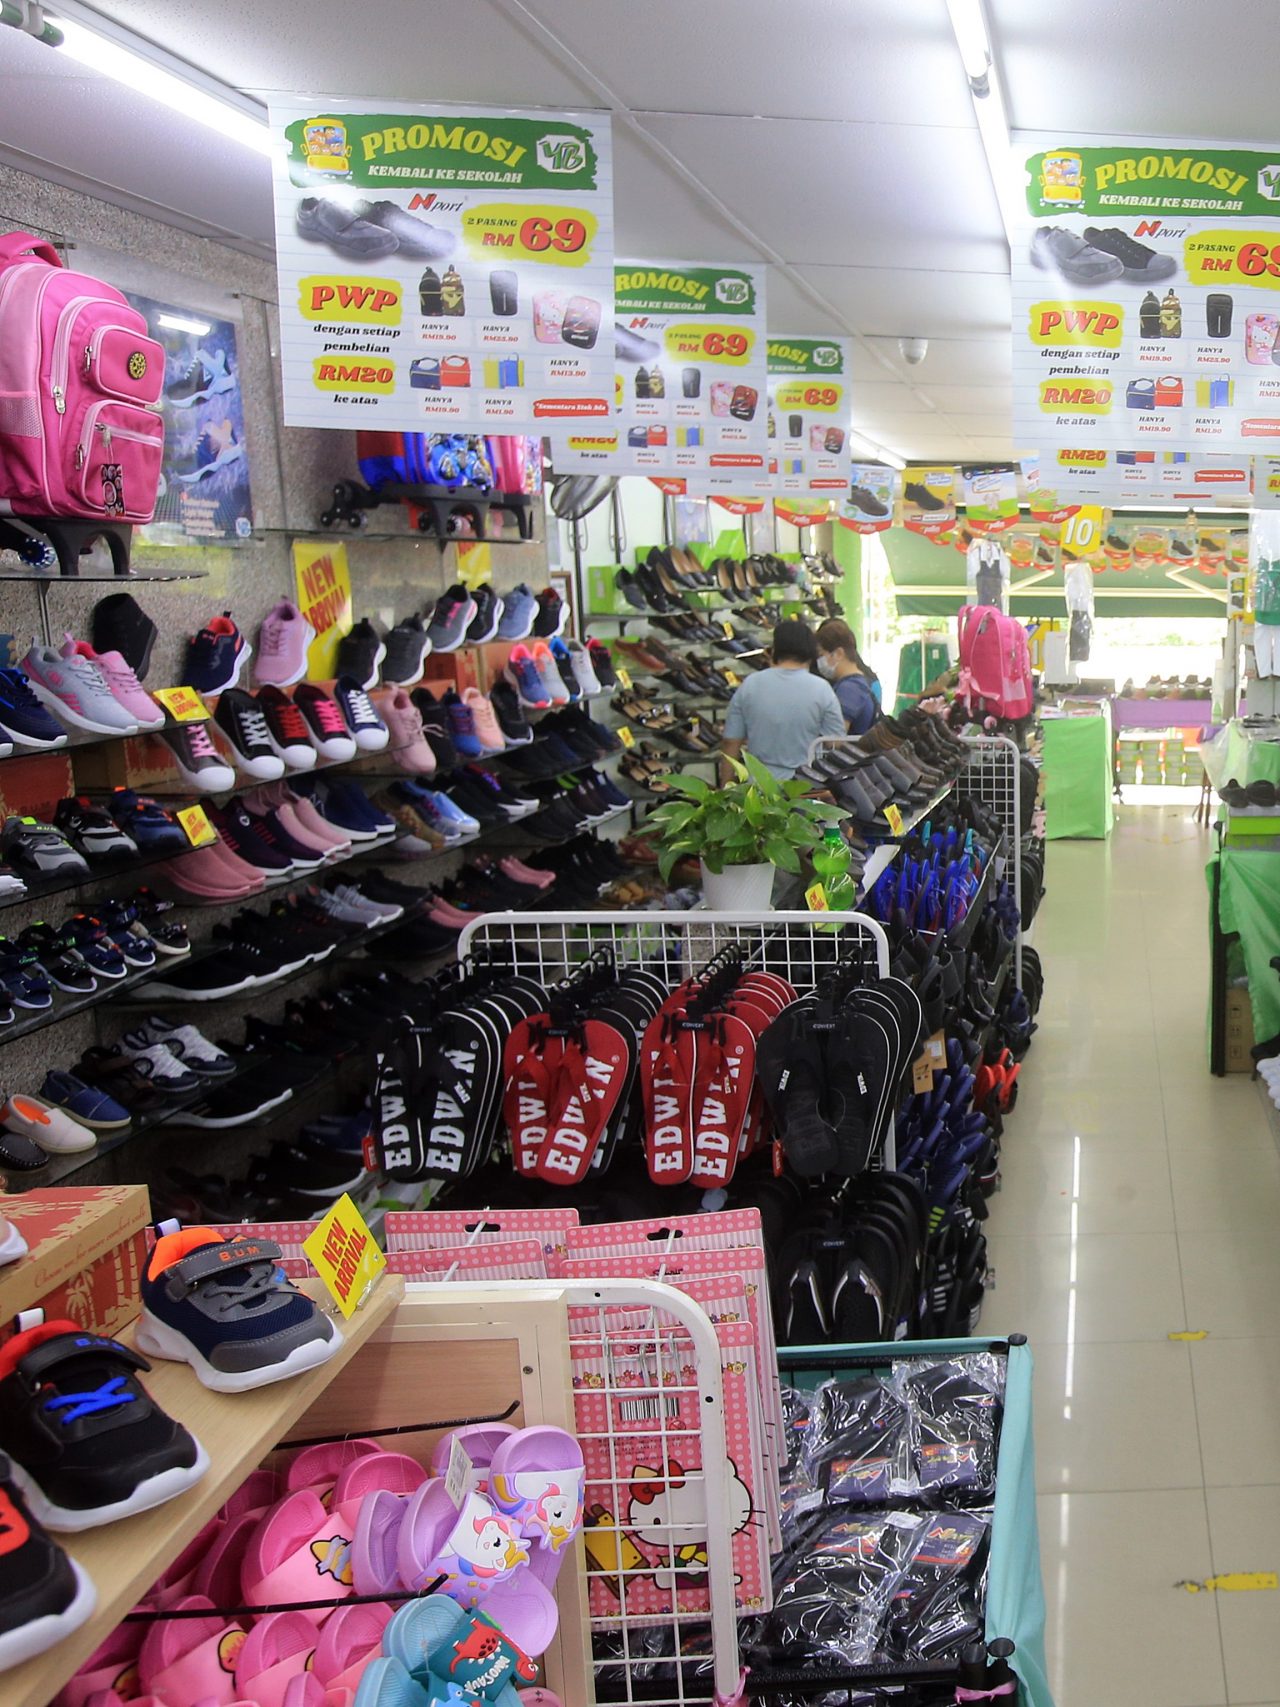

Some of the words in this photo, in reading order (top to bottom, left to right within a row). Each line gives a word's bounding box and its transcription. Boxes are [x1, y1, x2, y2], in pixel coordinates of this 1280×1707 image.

[361, 124, 527, 168] PROMOSI
[367, 165, 433, 179] KEMBALI
[435, 168, 456, 180] KE
[457, 169, 523, 183] SEKOLAH
[1095, 155, 1250, 196] PROMOSI
[1099, 194, 1160, 207] KEMBALI
[1162, 197, 1181, 209] KE
[1182, 198, 1243, 211] SEKOLAH
[467, 217, 475, 225] 2
[476, 217, 517, 227] PASANG
[482, 232, 515, 247] RM
[519, 217, 586, 253] 69
[1189, 243, 1196, 251] 2
[1197, 243, 1236, 253] PASANG
[1201, 257, 1232, 272] RM
[615, 271, 710, 300] ROMOSI
[310, 284, 398, 313] PWP
[313, 323, 359, 337] dengan
[361, 326, 401, 338] setiap
[1039, 309, 1120, 337] PWP
[323, 341, 390, 354] pembelian
[678, 342, 699, 353] RM
[703, 332, 748, 356] 69
[1197, 346, 1223, 354] HANYA
[767, 343, 809, 364] MOSI
[1041, 348, 1082, 360] dengan
[1084, 349, 1120, 361] setiap
[550, 359, 579, 367] HANYA
[1049, 364, 1110, 376] pembelian
[318, 364, 394, 384] RM20
[333, 394, 348, 404] ke
[349, 395, 379, 406] atas
[804, 388, 838, 406] 69
[1042, 387, 1111, 406] RM20
[1056, 416, 1068, 426] ke
[1070, 416, 1097, 426] atas
[301, 553, 337, 602] NEW
[425, 1050, 476, 1173] EDWN
[322, 1217, 348, 1271] NEW
[334, 1227, 368, 1304] ARRIVAL
